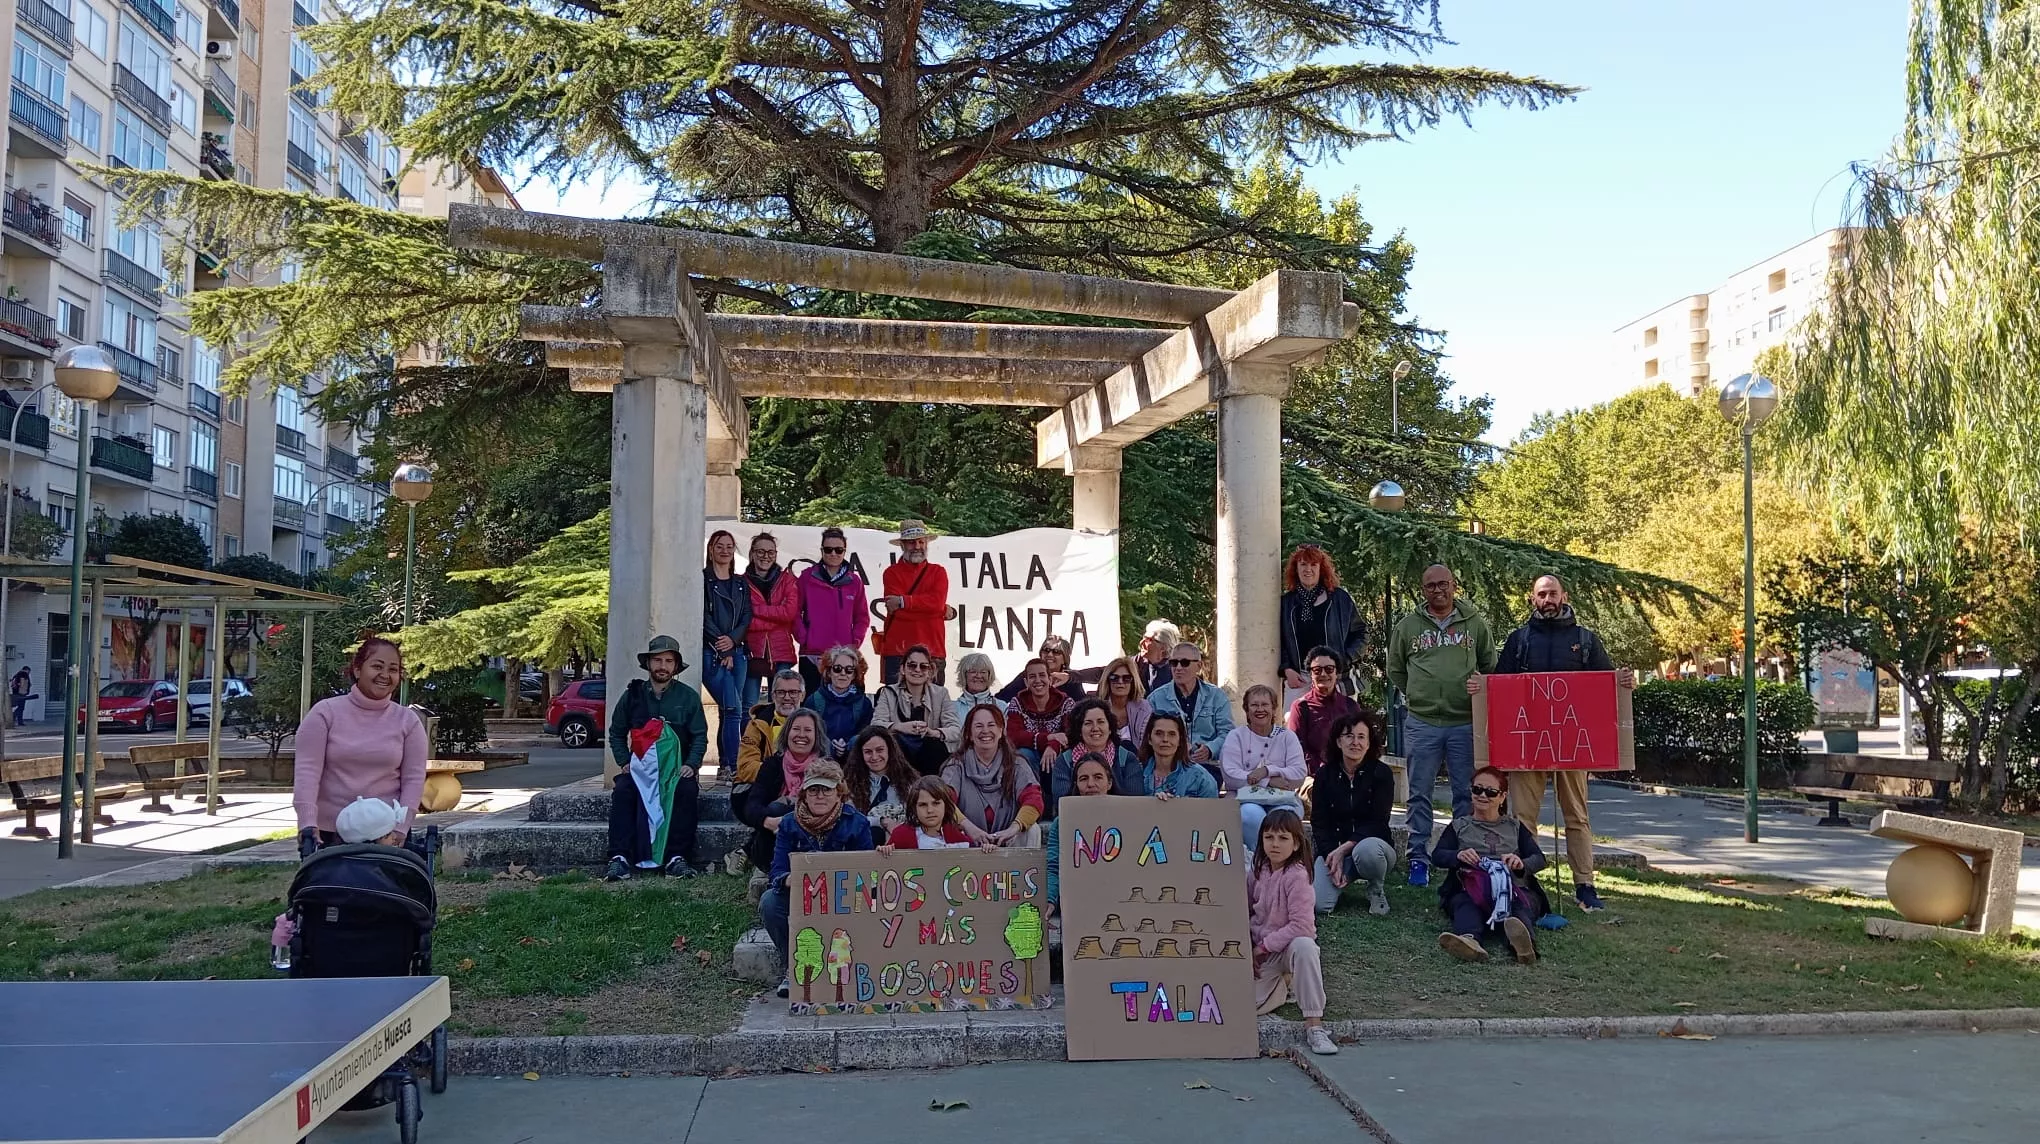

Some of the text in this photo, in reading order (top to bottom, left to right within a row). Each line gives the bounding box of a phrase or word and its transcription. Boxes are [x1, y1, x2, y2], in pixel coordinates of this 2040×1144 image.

[949, 552, 1052, 590] TALA
[1532, 676, 1568, 702] NO
[1516, 704, 1579, 728] A LA
[1509, 728, 1595, 763] TALA
[1073, 826, 1232, 868] NO A LA
[803, 866, 1039, 915] MENOS COCHES
[880, 908, 976, 948] Y MÁS
[855, 960, 1019, 1002] BOSQUES
[1109, 981, 1223, 1025] TALA
[312, 1017, 412, 1112] Ayuntamiento de Huesca
